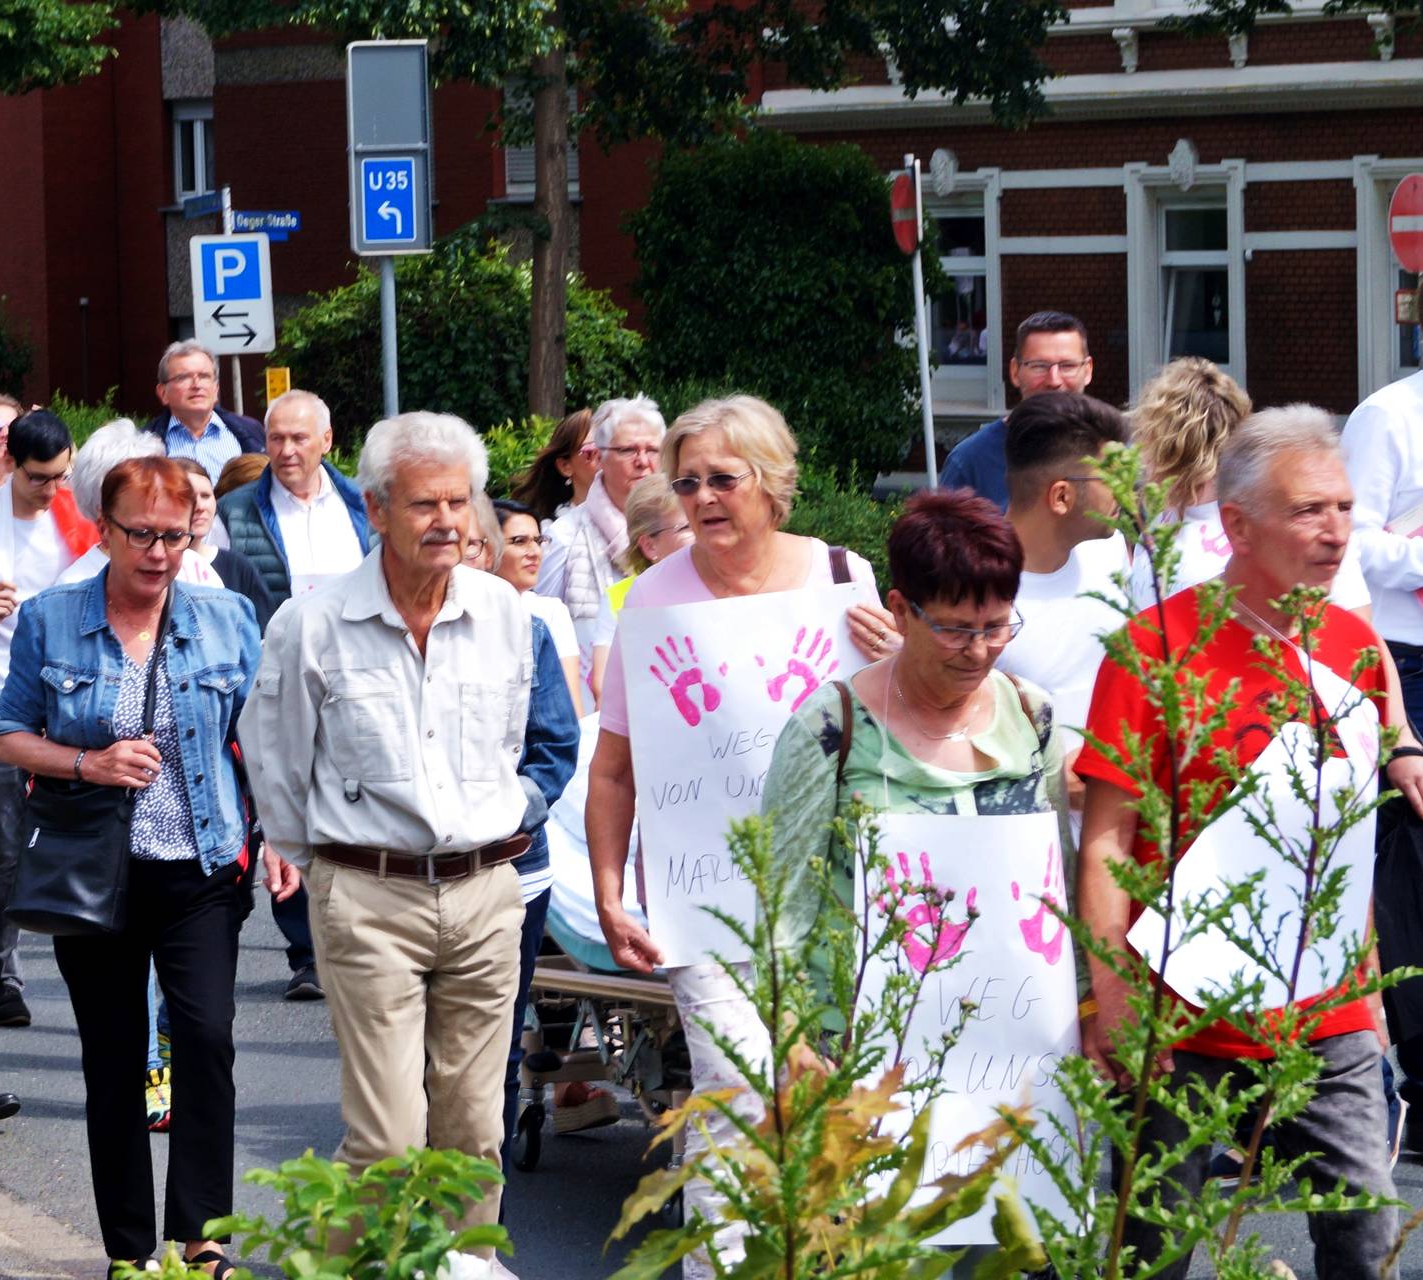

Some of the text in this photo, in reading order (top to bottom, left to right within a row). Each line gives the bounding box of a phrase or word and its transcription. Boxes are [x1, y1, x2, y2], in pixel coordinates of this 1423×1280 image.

[368, 170, 408, 191] U 35
[214, 248, 247, 295] P
[708, 727, 777, 760] WEG
[650, 776, 703, 811] VON
[938, 975, 1042, 1026] WEG
